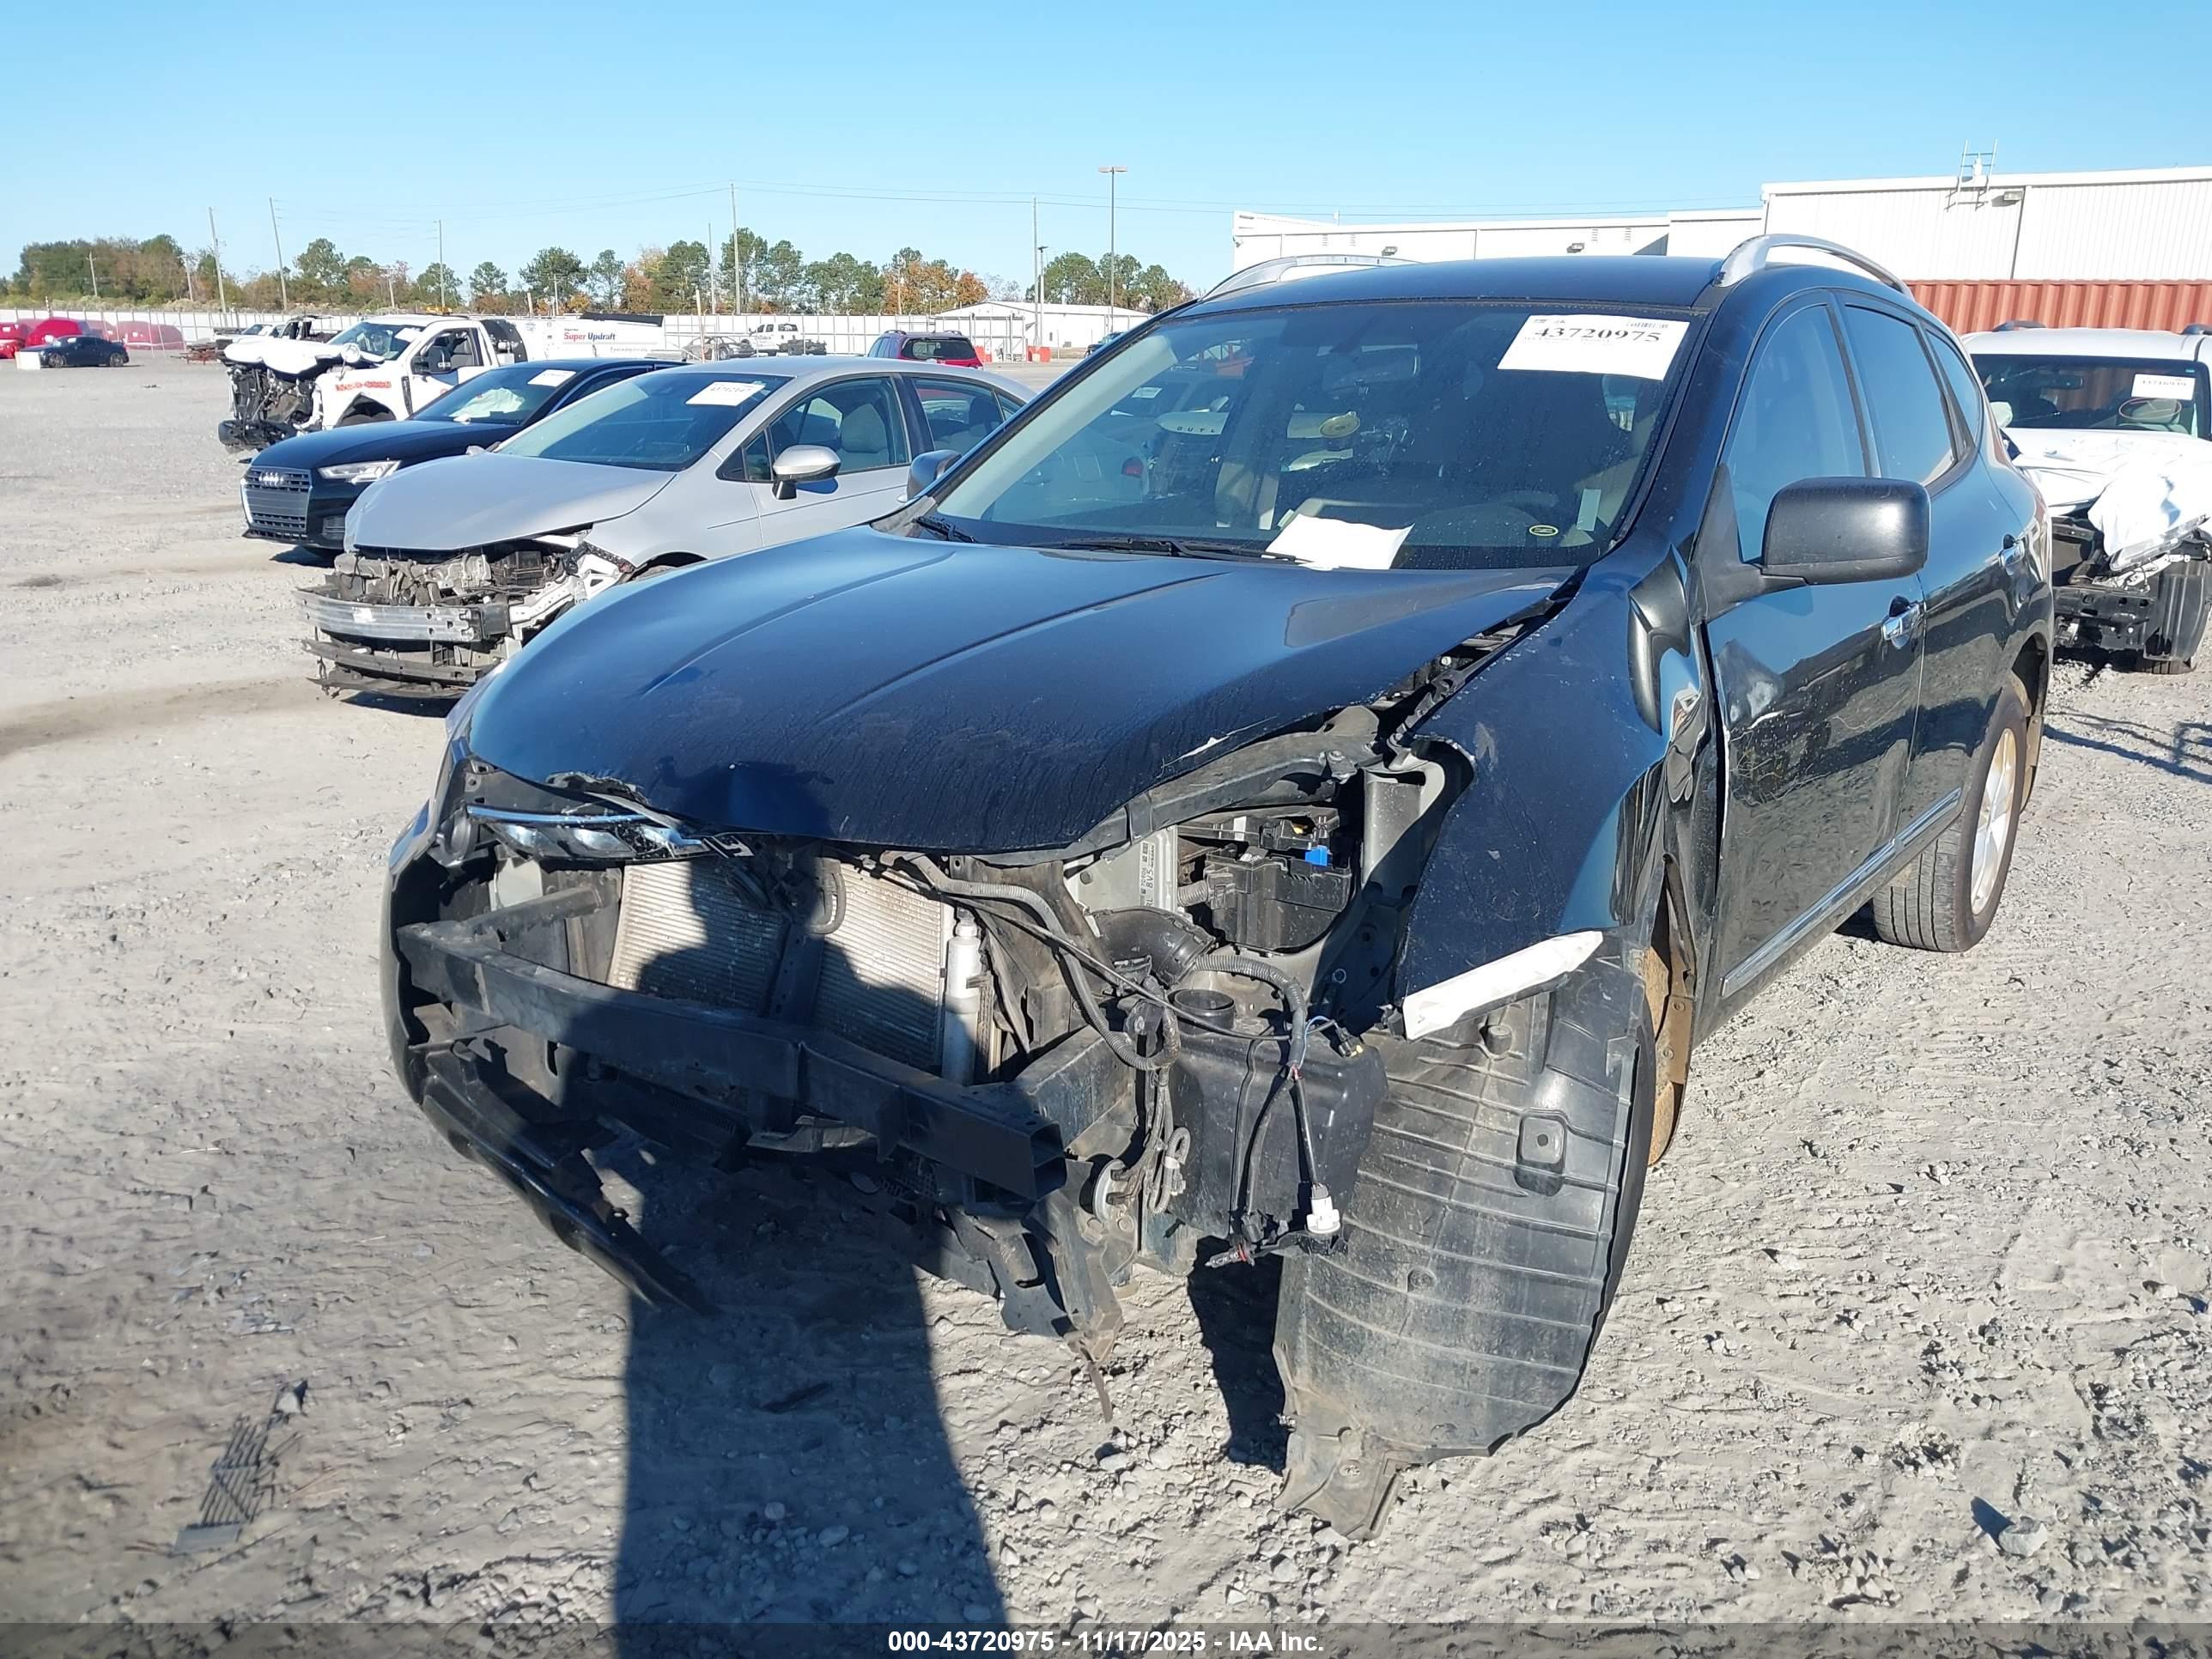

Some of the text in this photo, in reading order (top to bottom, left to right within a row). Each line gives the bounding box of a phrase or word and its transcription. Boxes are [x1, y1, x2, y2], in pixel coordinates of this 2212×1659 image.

[563, 331, 616, 342] Super Updraft
[1534, 327, 1661, 343] 43720975
